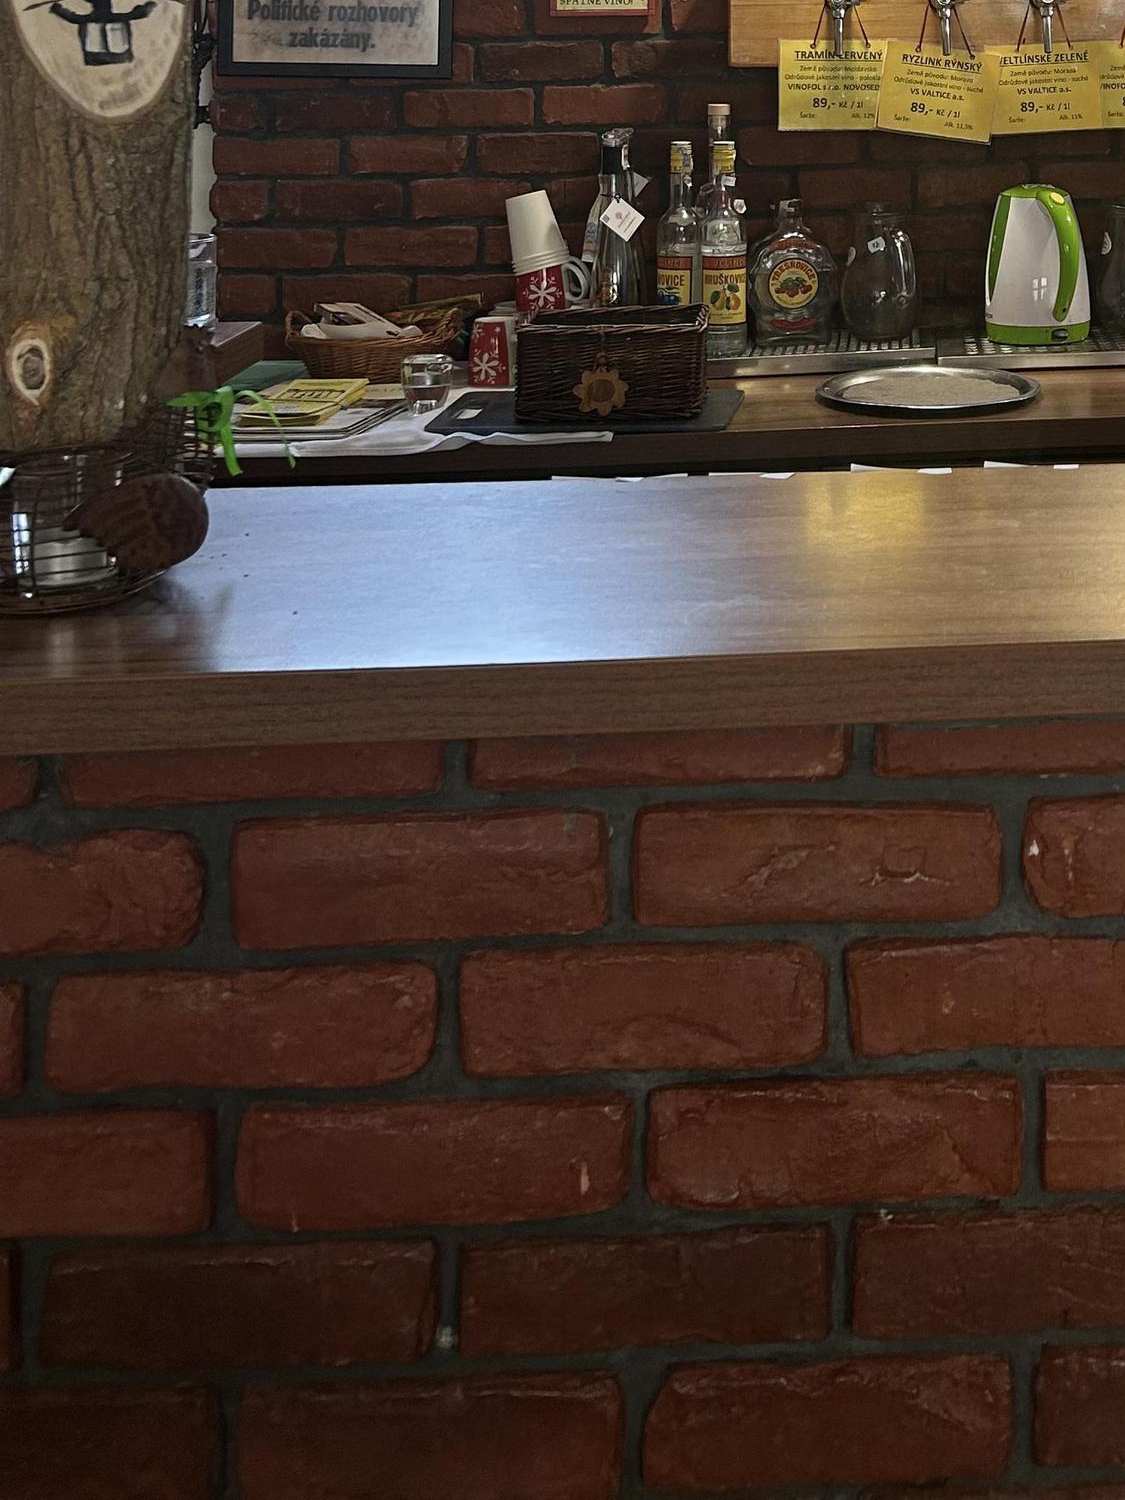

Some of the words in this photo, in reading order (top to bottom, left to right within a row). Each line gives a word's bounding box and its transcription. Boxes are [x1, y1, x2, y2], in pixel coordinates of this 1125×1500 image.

[328, 0, 419, 27] rozhovory
[288, 27, 376, 53] zakázány.
[795, 49, 836, 60] TRAMÍN
[1054, 50, 1089, 62] ZELENÉ
[902, 53, 942, 67] RYZLINK
[944, 57, 983, 73] RÝNSKÝ
[787, 83, 821, 91] VINOFOL
[843, 83, 880, 91] NOVOSED
[910, 87, 920, 95] VS
[921, 88, 951, 99] VALTICE
[1017, 87, 1027, 95] VS
[1028, 87, 1058, 95] VALTICE
[812, 97, 836, 110] 89,-
[910, 102, 933, 116] 89,-
[936, 108, 945, 117] Kč
[1020, 101, 1043, 113] 89,-
[1046, 103, 1055, 111] Kč
